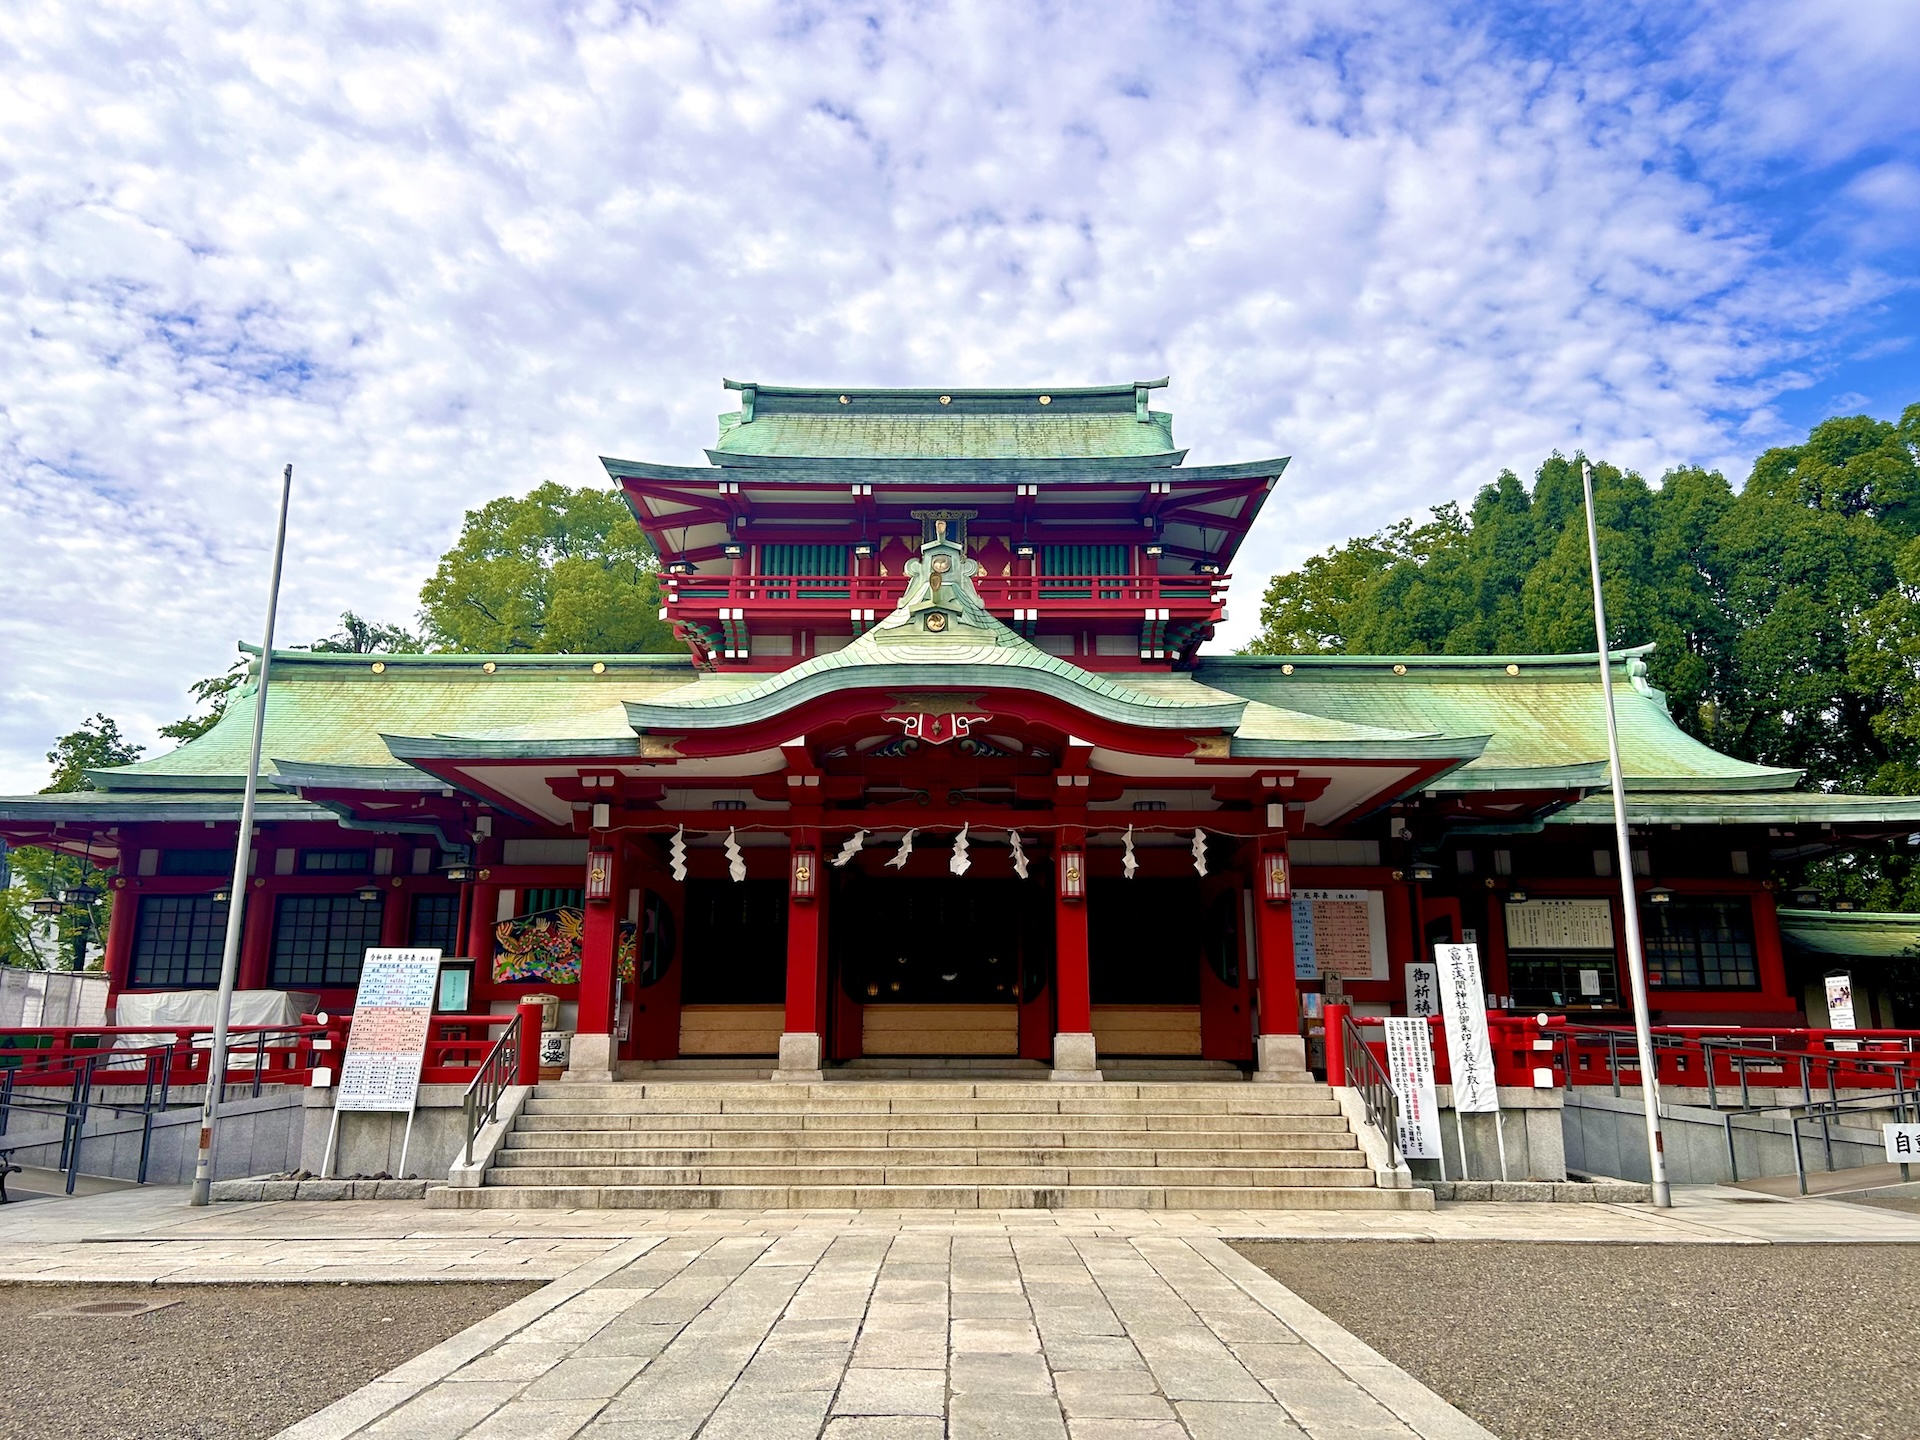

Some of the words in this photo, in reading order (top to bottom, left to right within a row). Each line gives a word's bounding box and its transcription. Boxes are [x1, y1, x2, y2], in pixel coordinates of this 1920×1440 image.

[1465, 946, 1476, 985] 七月一日より
[1412, 967, 1432, 1017] 御祈祷
[1418, 1020, 1429, 1073] 令和六年二月中旬より
